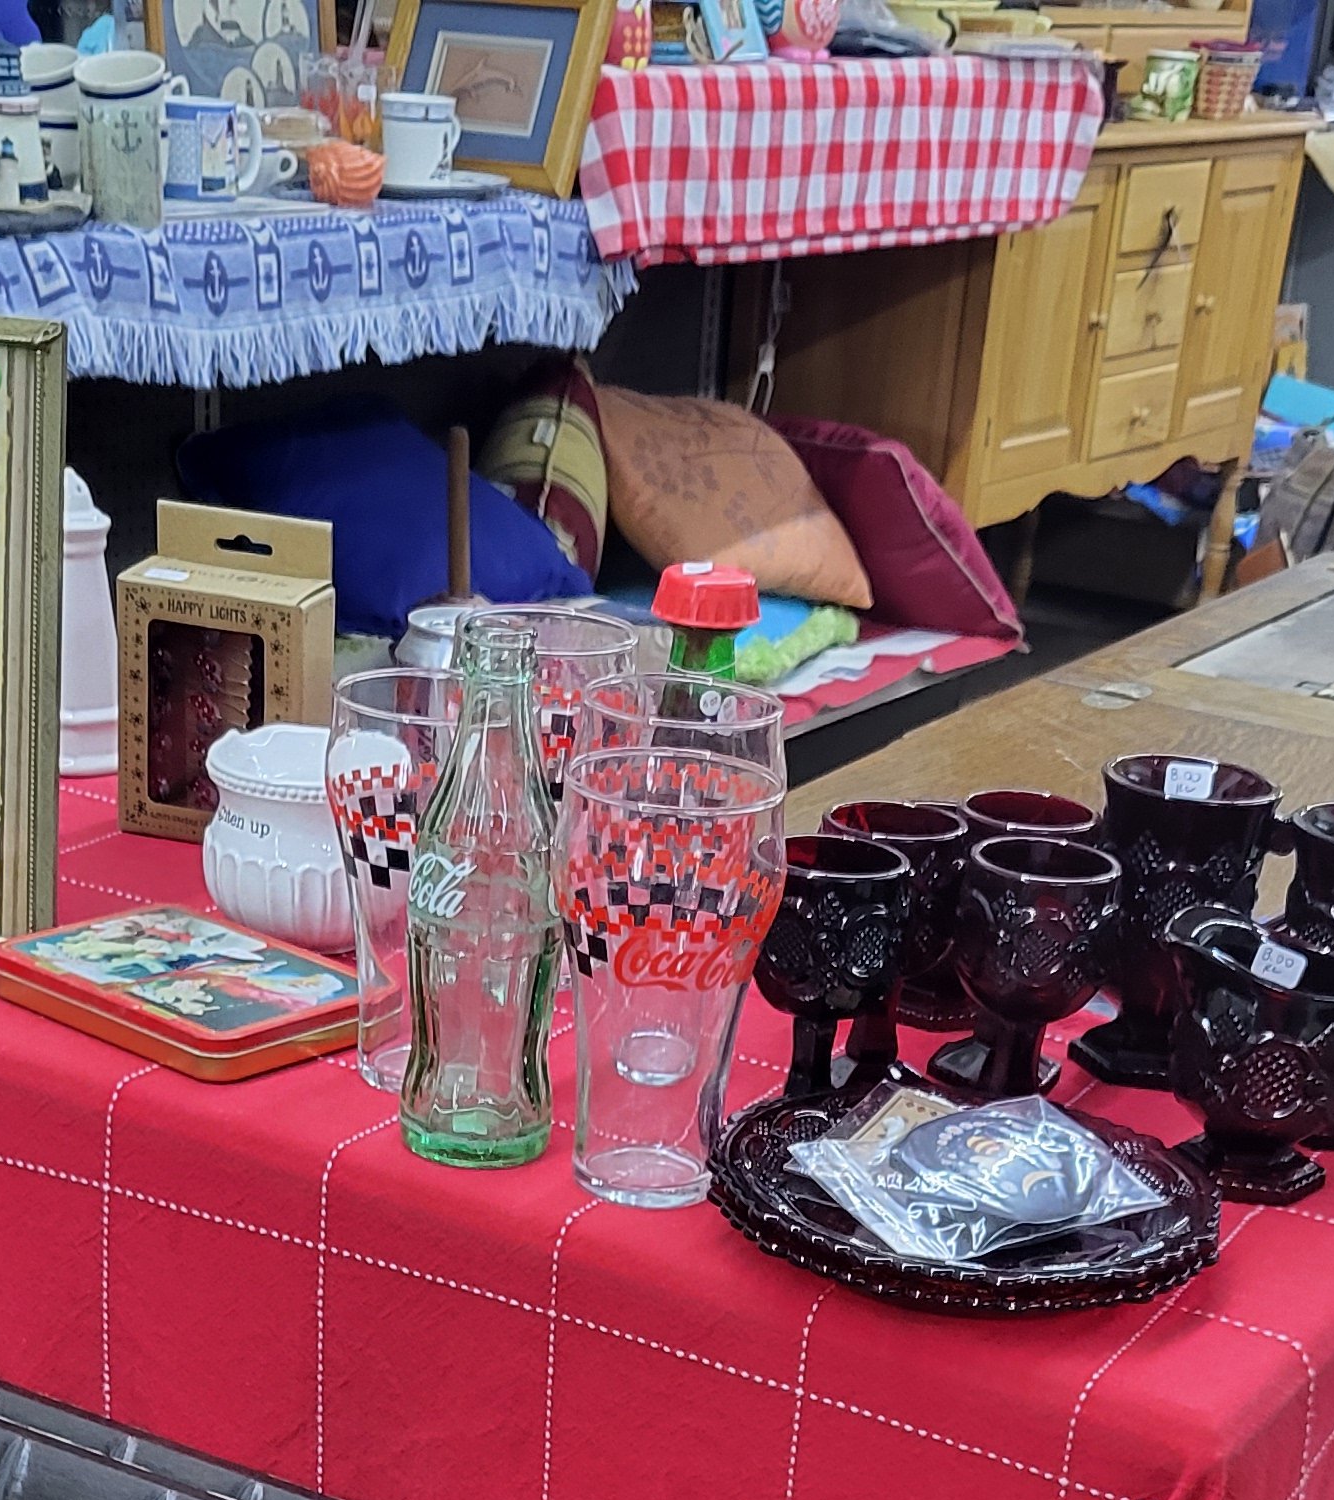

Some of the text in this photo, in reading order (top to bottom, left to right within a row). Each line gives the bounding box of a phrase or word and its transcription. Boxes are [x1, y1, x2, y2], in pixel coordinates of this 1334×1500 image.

[167, 597, 248, 625] HAPPY LIGHTS
[250, 820, 271, 838] up
